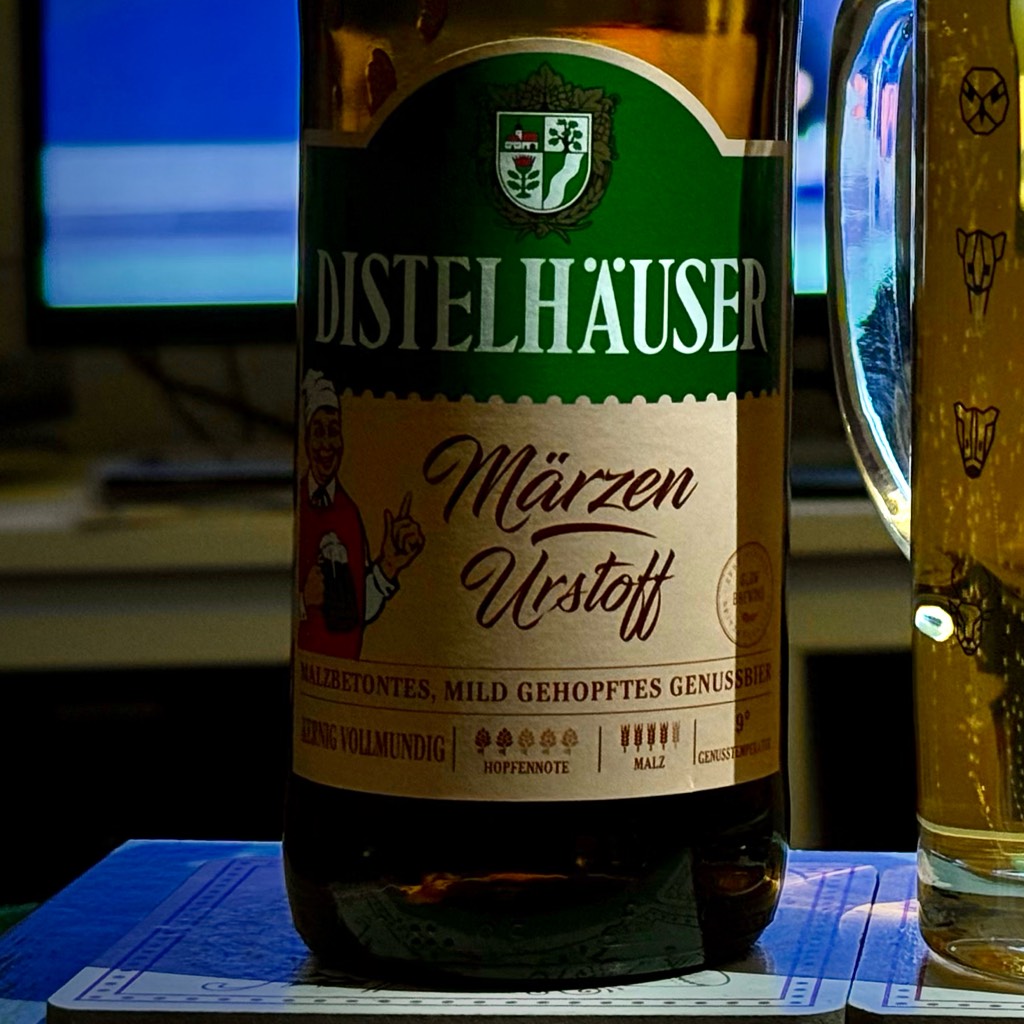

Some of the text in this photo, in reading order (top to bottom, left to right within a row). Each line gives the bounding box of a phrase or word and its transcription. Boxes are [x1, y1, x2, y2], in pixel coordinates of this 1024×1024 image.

[315, 248, 768, 356] DISTELHÄUSER
[423, 433, 699, 533] Märzen
[460, 546, 676, 642] Urstoff
[444, 679, 508, 703] MILD
[516, 676, 663, 703] GEHOPFTES
[669, 661, 773, 697] GENUSSBIER
[339, 725, 446, 763] VOLLMUNDIG
[632, 755, 666, 771] MALZ
[483, 759, 570, 775] HOPFENNOTE
